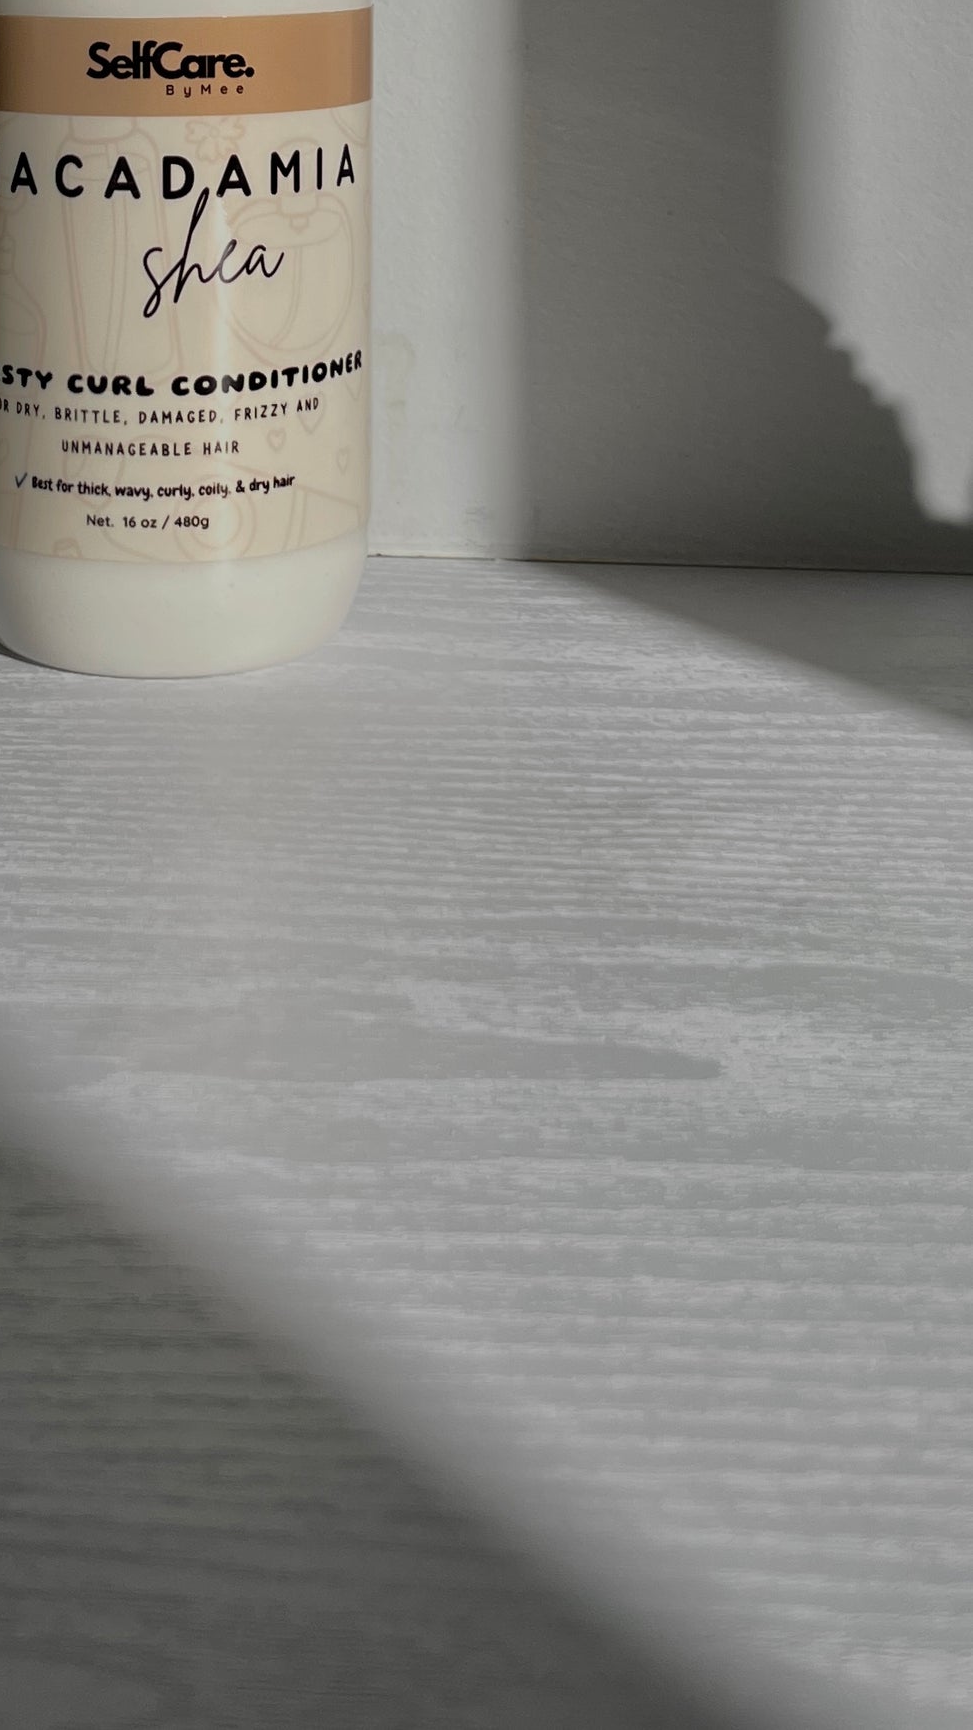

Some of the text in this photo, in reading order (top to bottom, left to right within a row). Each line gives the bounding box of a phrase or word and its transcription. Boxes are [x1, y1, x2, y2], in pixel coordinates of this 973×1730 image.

[86, 40, 255, 80] SelfCare.
[142, 187, 284, 318] shea
[67, 374, 155, 397] CURL
[171, 350, 363, 396] CONDITIONER
[16, 401, 46, 419] DRY,
[54, 407, 127, 425] BRITTLE,
[138, 410, 224, 424] DAMAGED,
[234, 402, 288, 421] FRIZZY
[296, 397, 319, 413] AND
[61, 439, 240, 456] UNMANAGEABLE HAIR
[31, 476, 54, 491] Best
[56, 479, 74, 494] for
[235, 480, 245, 493] &
[249, 477, 270, 494] dry
[273, 474, 295, 488] hair
[86, 514, 209, 530] Net. 16 oz / 480g
